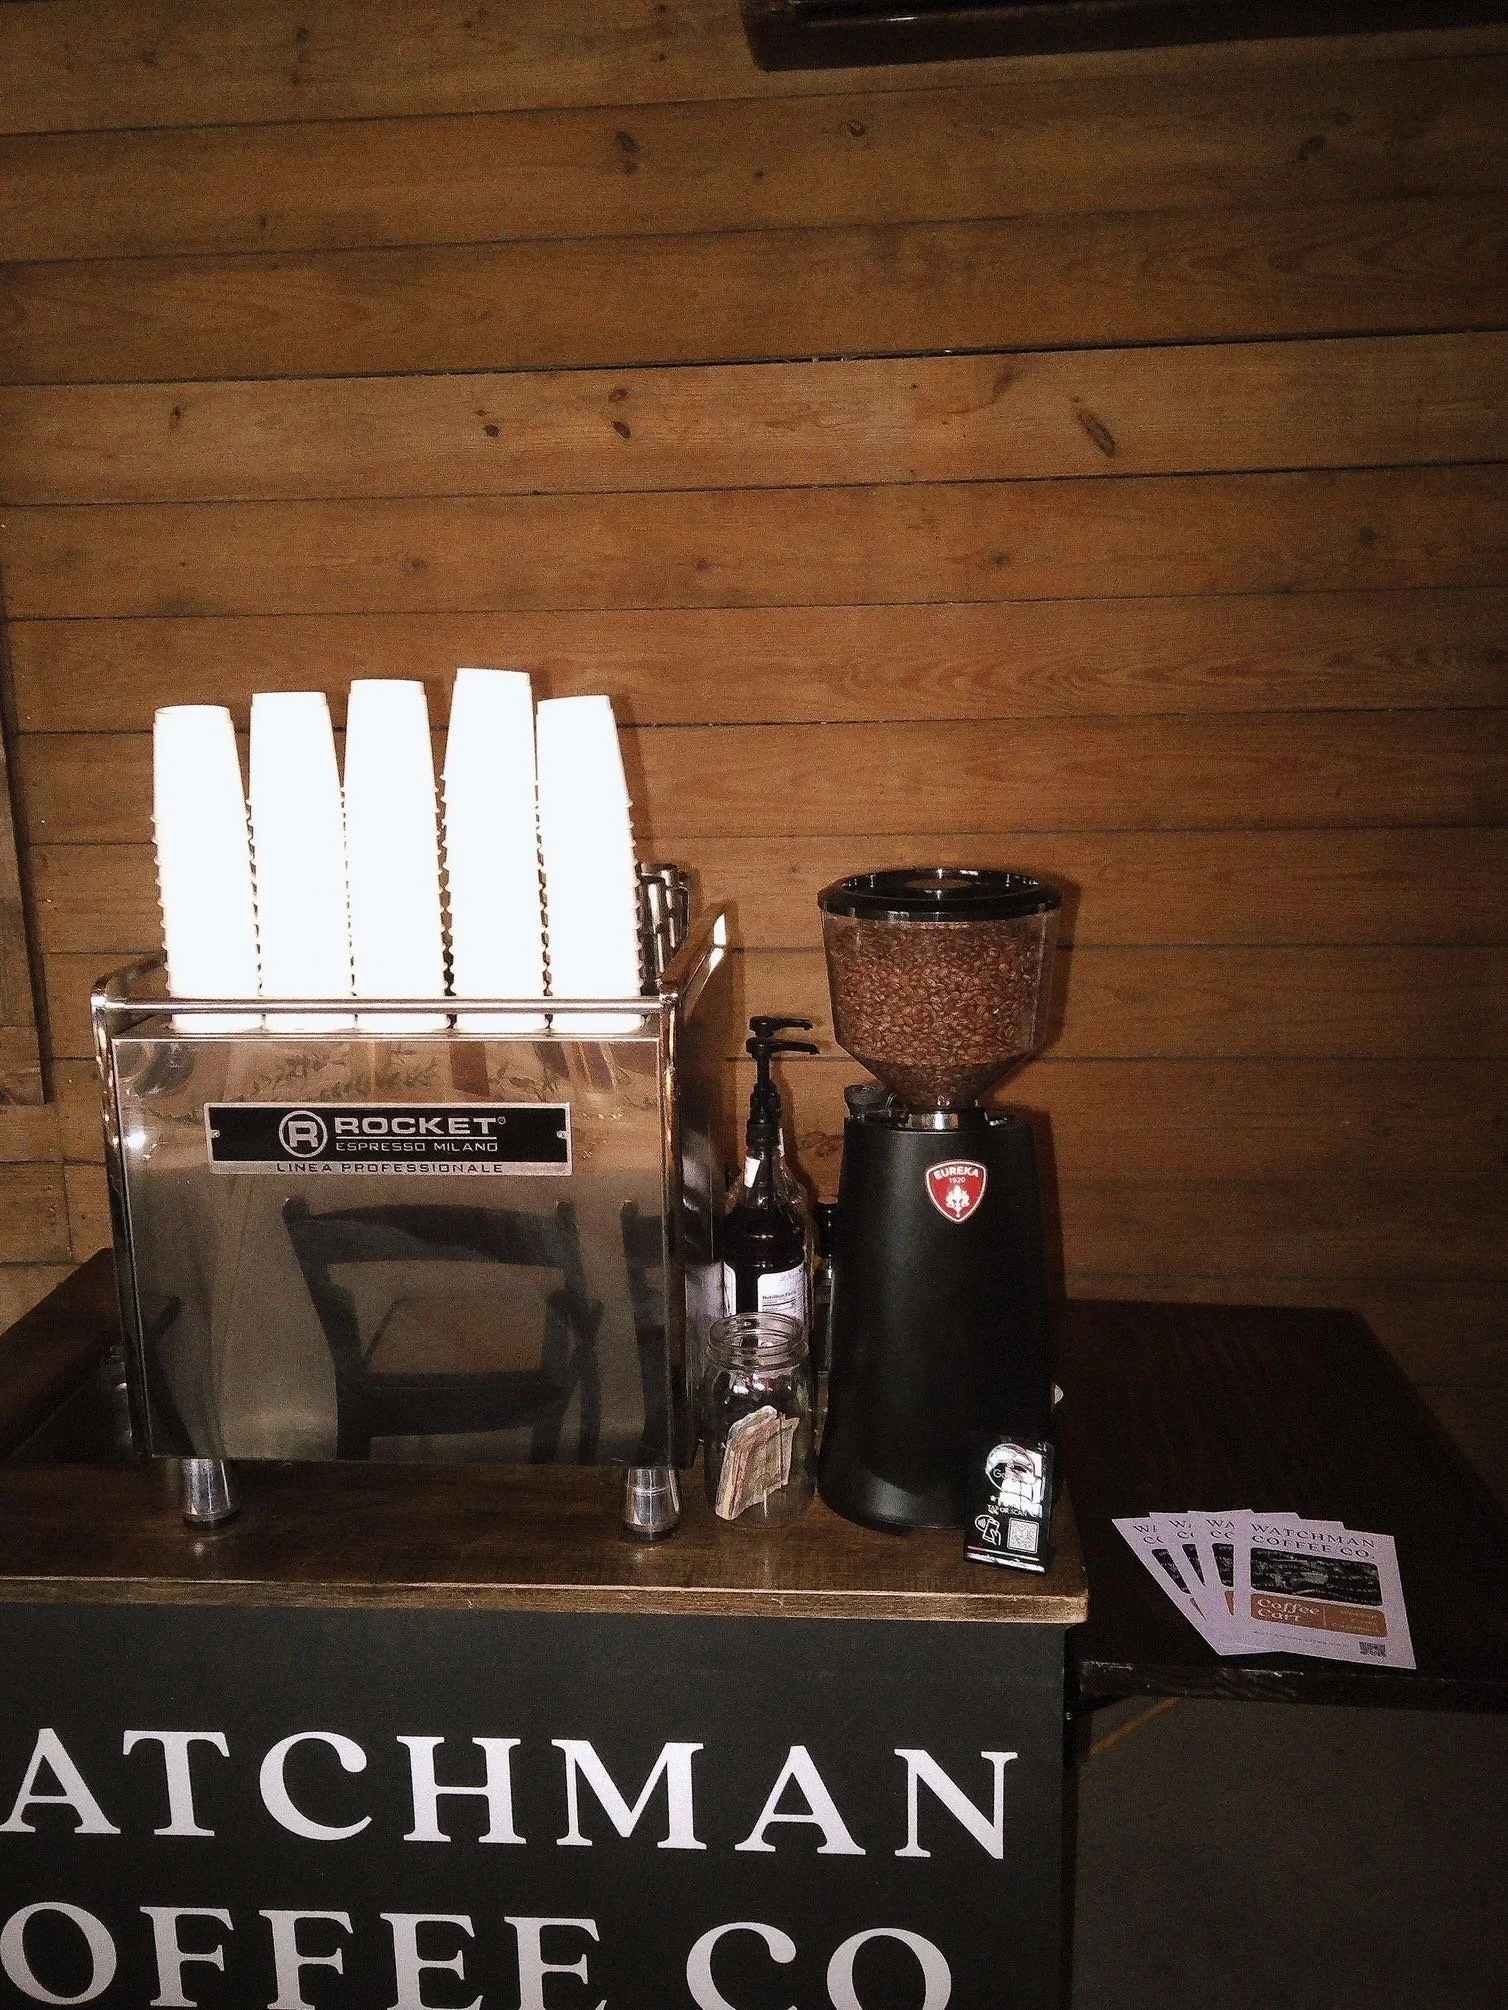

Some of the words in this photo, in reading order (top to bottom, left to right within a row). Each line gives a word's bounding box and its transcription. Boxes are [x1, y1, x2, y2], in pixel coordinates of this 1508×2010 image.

[335, 1142, 425, 1152] ESPRESSO
[434, 1142, 498, 1153] MILANO
[276, 1163, 332, 1173] LINEA
[341, 1163, 503, 1174] PROFESSIONALE
[933, 1166, 979, 1180] EUREKA
[1250, 1523, 1376, 1548] WATCHMAN
[1251, 1534, 1332, 1553] COFFEE
[1257, 1598, 1320, 1615] Coffee
[1257, 1608, 1302, 1623] Cart
[0, 1902, 606, 2010] OFFEE
